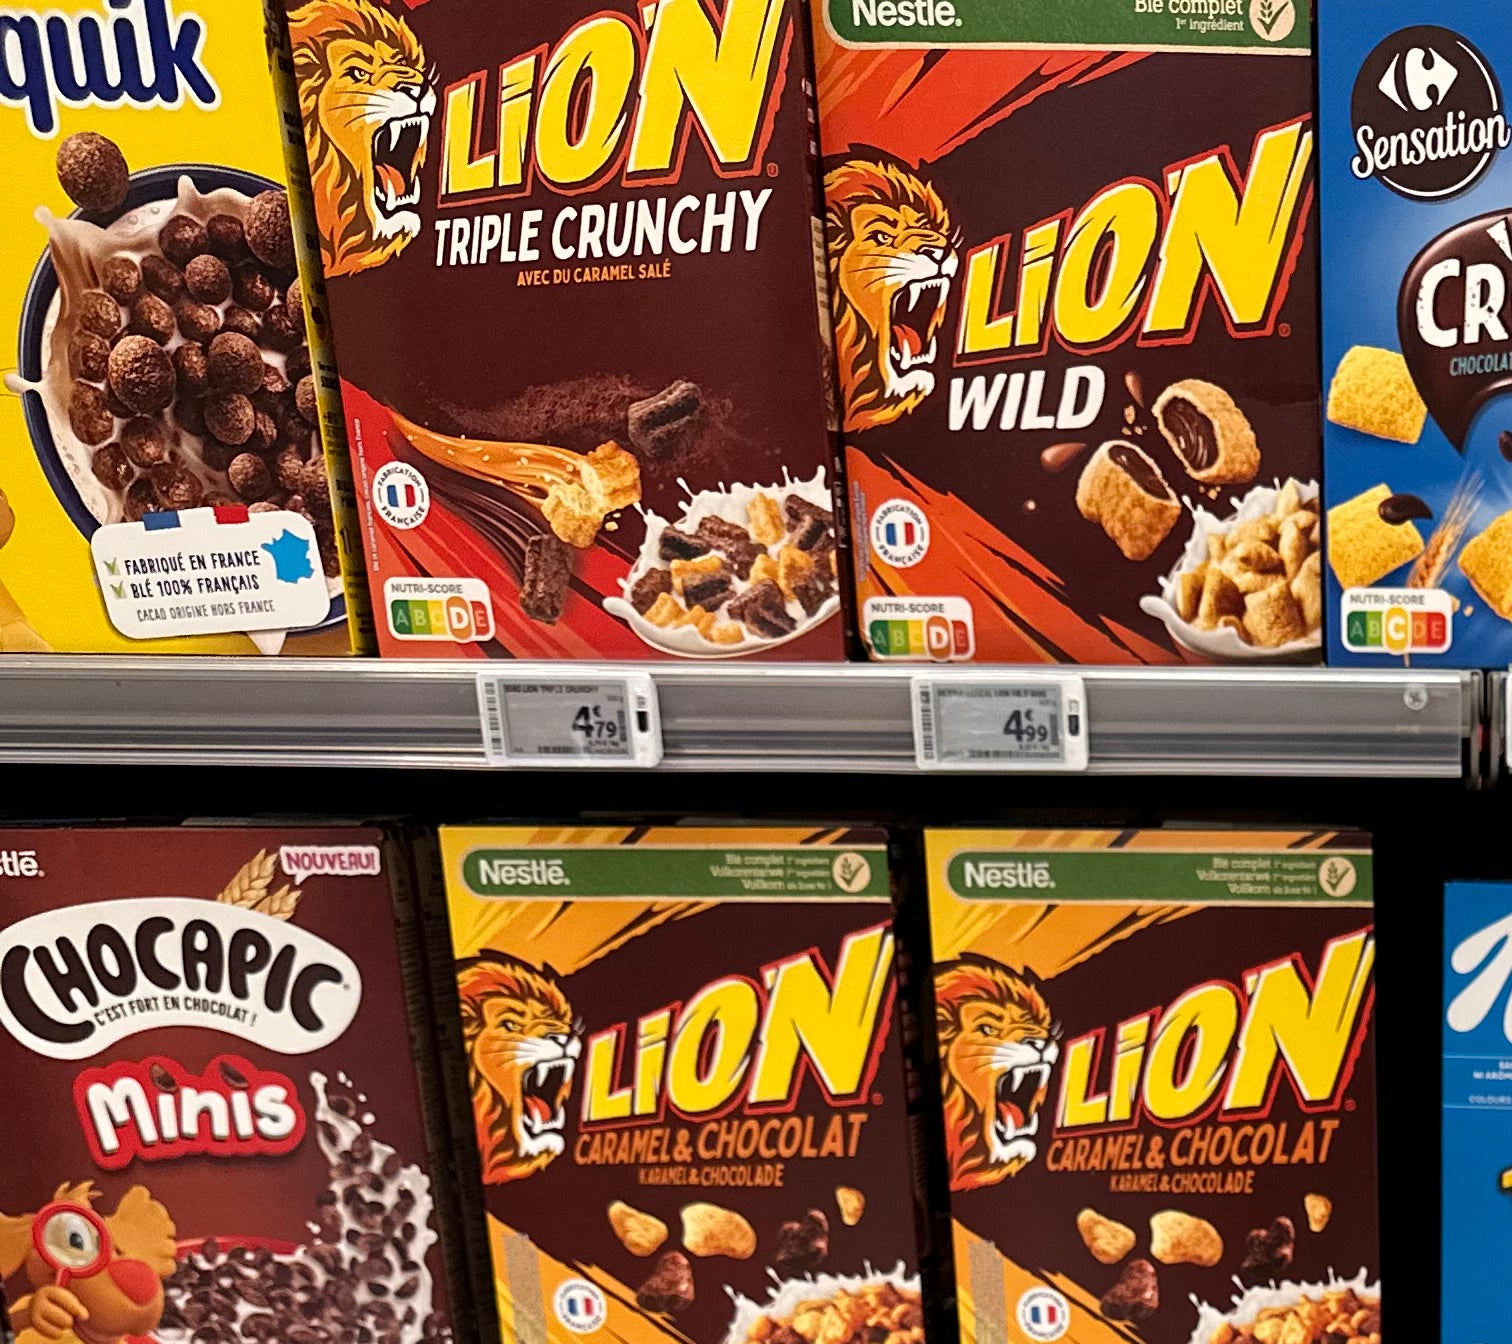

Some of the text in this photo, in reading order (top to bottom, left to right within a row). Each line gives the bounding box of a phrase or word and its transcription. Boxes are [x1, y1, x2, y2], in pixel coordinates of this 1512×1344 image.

[1352, 111, 1511, 179] Sensation
[435, 188, 773, 267] TRIPLE CRUNCHY
[954, 116, 1312, 365] LION
[517, 257, 671, 287] AVEC DU CARAMEL SALÉ
[949, 365, 1105, 431] WILD
[125, 548, 261, 576] FABRIQUÉ EN FRANCE
[131, 573, 260, 600] BLÉ 100% FRANÇAIS
[390, 583, 464, 595] NUTRI-SCORE
[1349, 594, 1426, 606] NUTRI-SCORE
[137, 600, 275, 623] CACAO ORIGINE HORS FRANCE
[871, 602, 945, 614] NUTRI-SCORE
[480, 859, 571, 887] Nestlé
[964, 862, 1056, 890] Nestlé
[0, 916, 344, 1044] CHOCAPIC
[129, 998, 162, 1018] FORT
[165, 996, 181, 1012] EN
[183, 996, 250, 1023] CHOCOLAT
[581, 920, 897, 1133] LION
[1051, 925, 1375, 1137] LION
[87, 1062, 297, 1155] Minis
[575, 1113, 867, 1166] CARAMEL CHOCOLAT
[1046, 1119, 1339, 1172] CARAMEL CHOCOLAT
